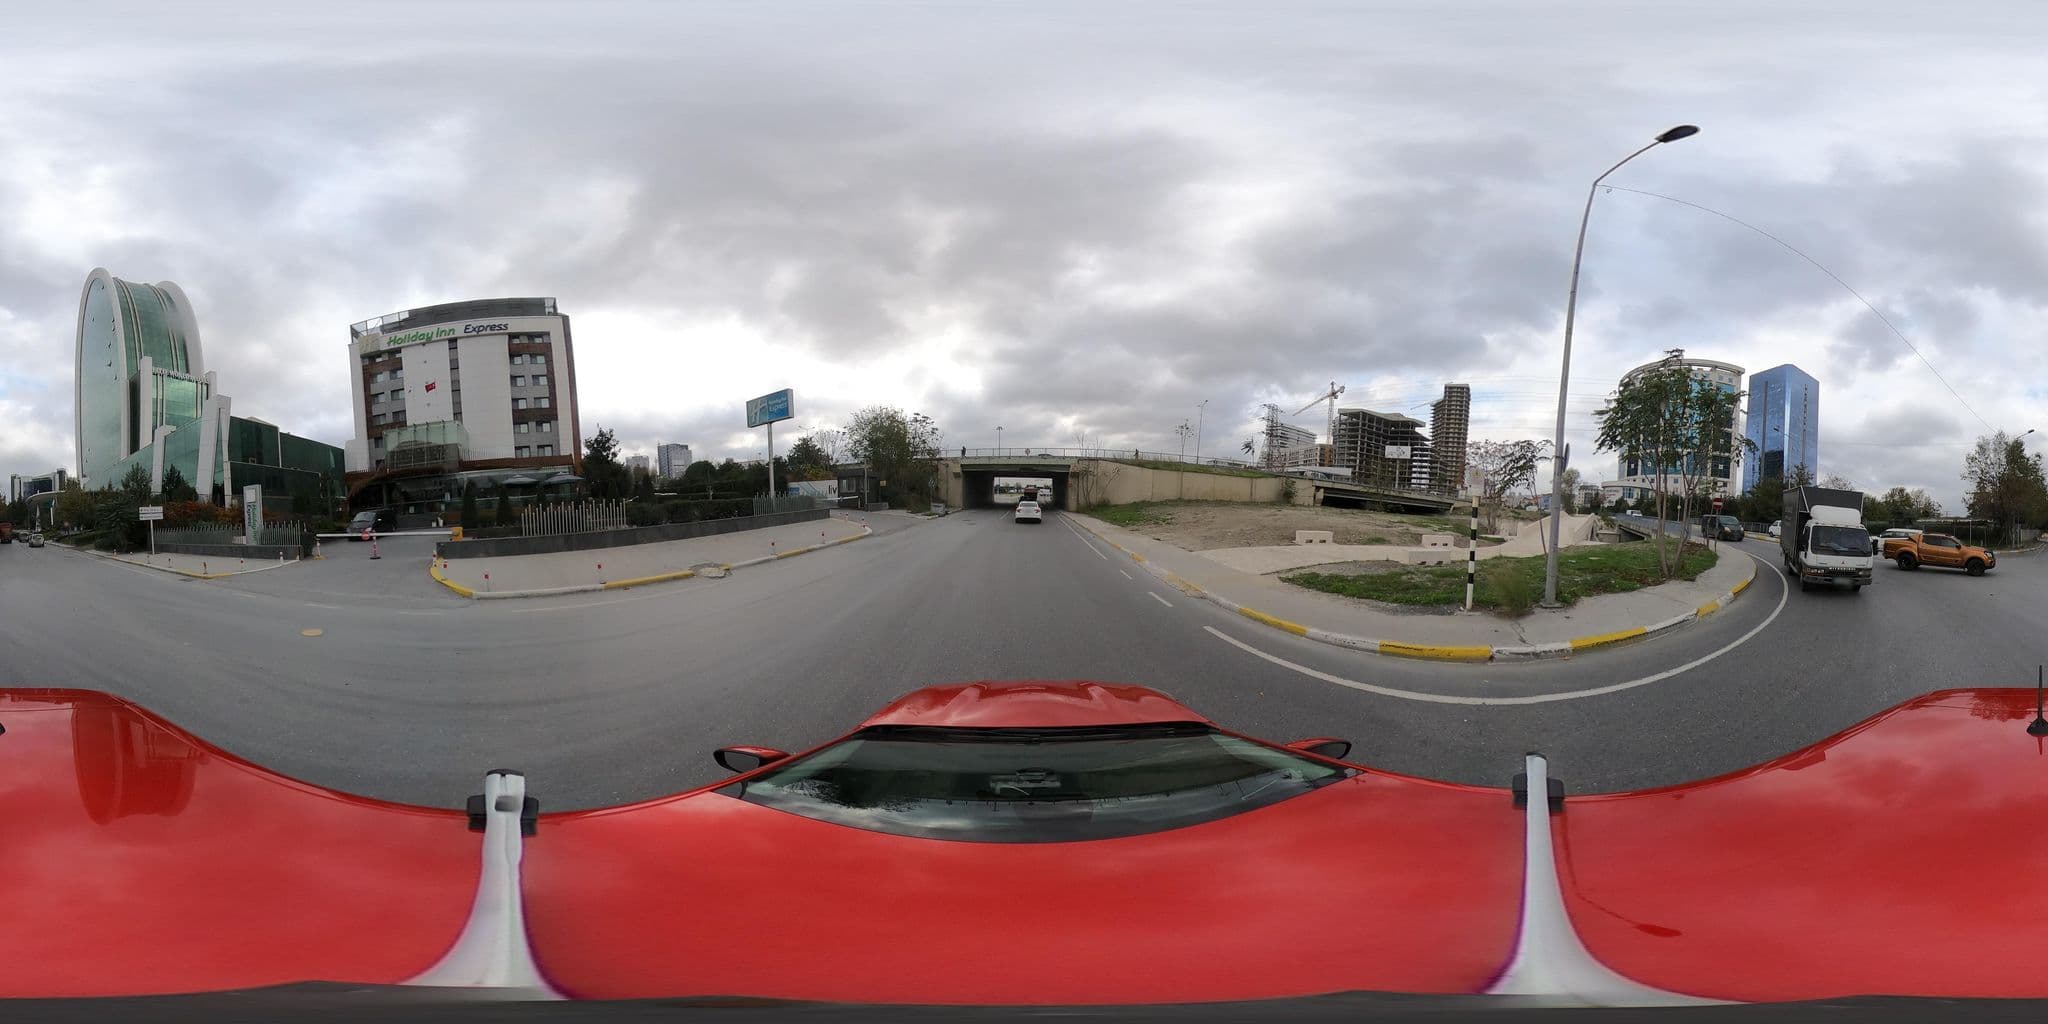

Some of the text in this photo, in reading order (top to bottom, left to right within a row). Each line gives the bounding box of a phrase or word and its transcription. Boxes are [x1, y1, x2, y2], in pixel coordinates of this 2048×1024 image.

[387, 322, 509, 346] Holiday Inn Express
